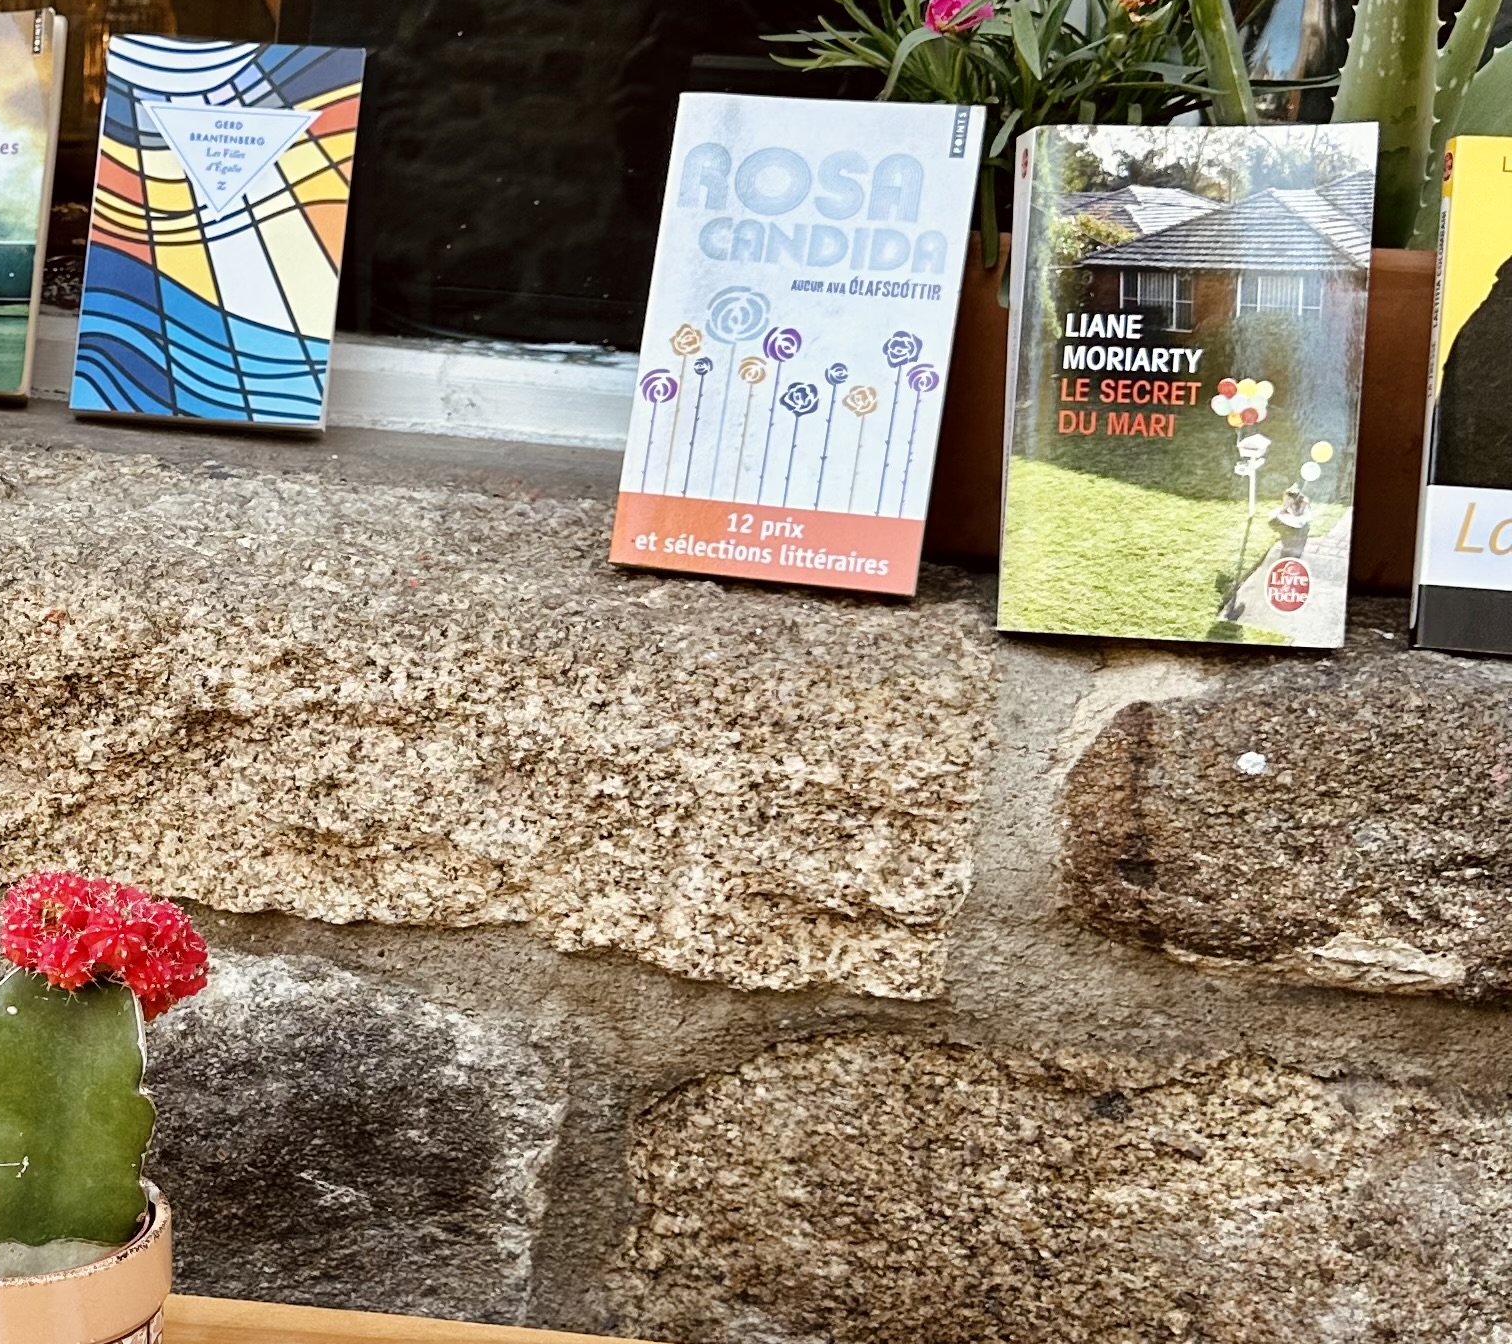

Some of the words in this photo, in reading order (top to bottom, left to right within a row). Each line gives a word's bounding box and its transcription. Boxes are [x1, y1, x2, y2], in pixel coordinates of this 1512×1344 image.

[952, 112, 968, 154] POINTS
[677, 142, 925, 223] ROSA
[698, 217, 948, 275] CANDIDA
[826, 281, 846, 295] AVA
[1064, 313, 1144, 340] LIANE
[1062, 346, 1204, 374] MORIARTY
[1059, 378, 1090, 403] LE
[1099, 379, 1203, 407] SECRET
[1057, 410, 1097, 436] DU
[1106, 411, 1176, 438] MARI
[726, 513, 753, 535] 12
[759, 518, 804, 542] prix
[635, 535, 658, 552] et
[663, 534, 772, 565] sélections
[778, 544, 889, 577] littéraires
[1271, 571, 1309, 586] Livre
[1268, 586, 1309, 603] Poche
